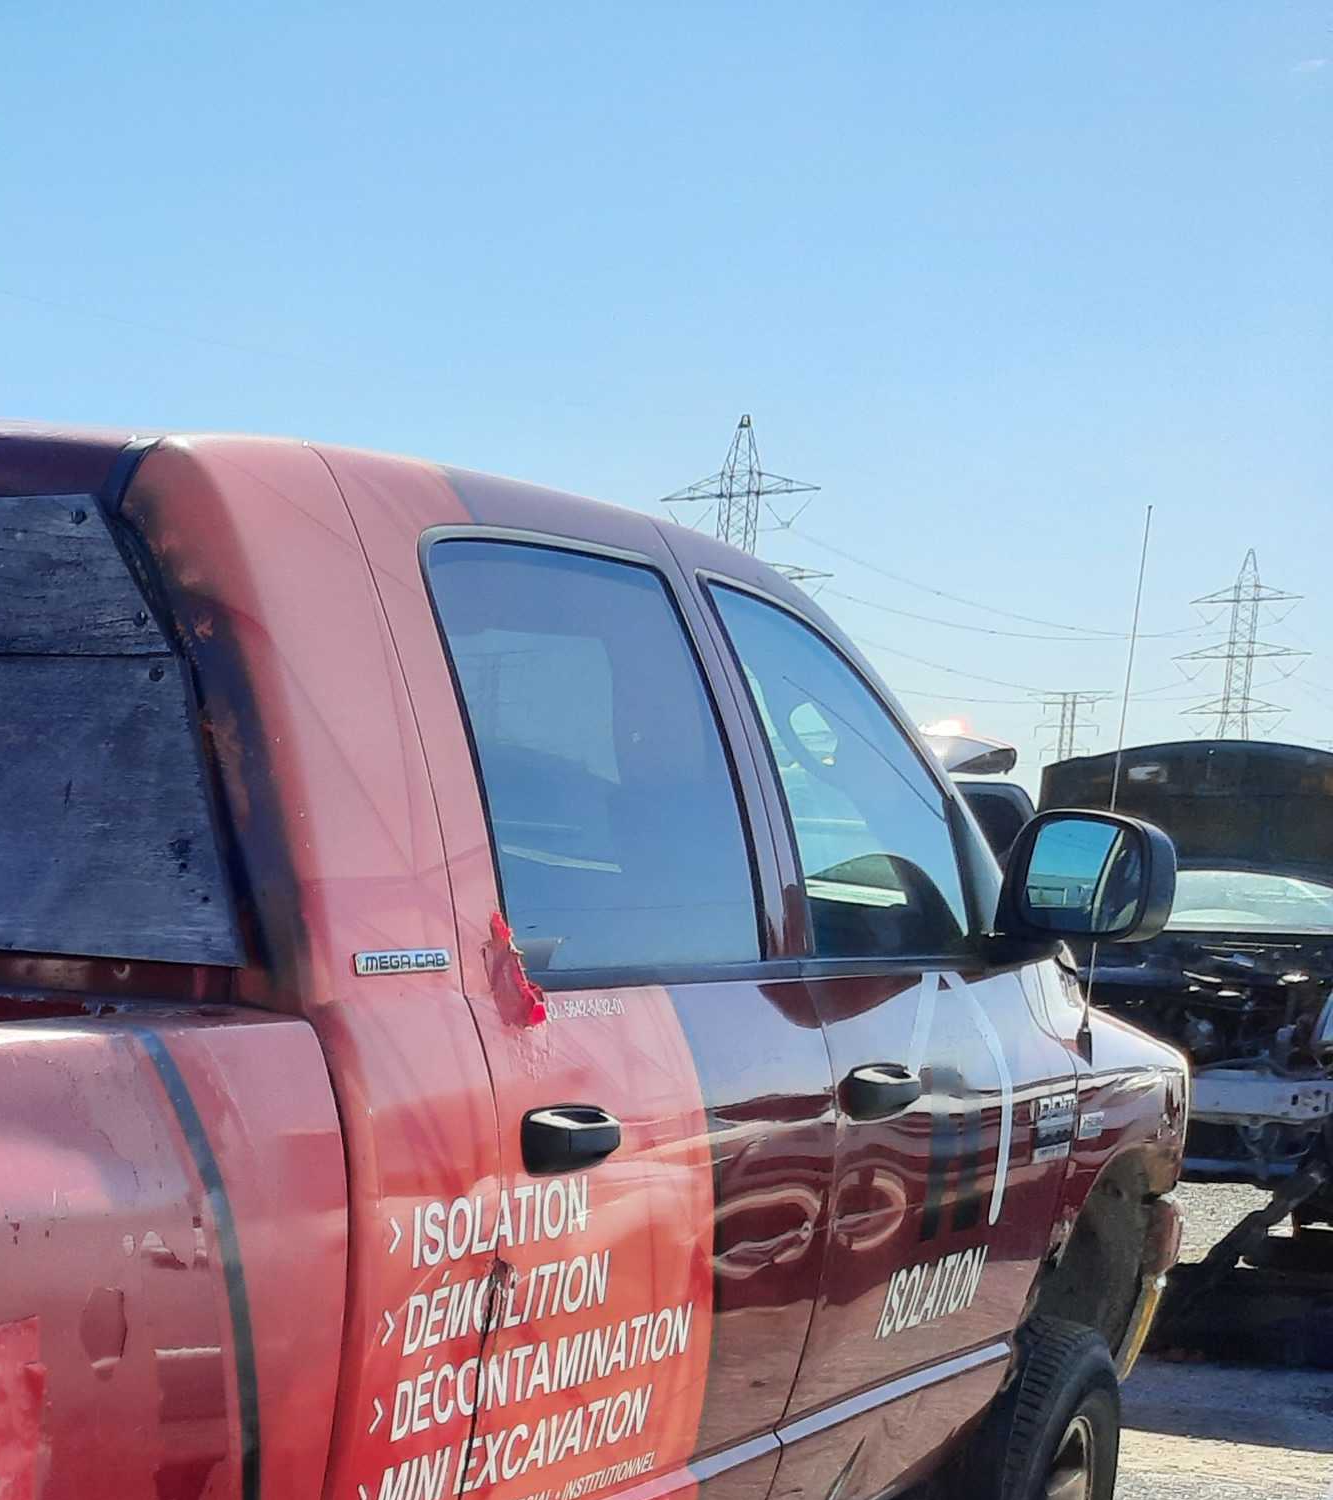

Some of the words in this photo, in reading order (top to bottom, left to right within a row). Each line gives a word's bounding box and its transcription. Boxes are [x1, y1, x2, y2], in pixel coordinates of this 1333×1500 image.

[364, 954, 411, 972] MEGA
[415, 952, 447, 968] CAB
[412, 1175, 589, 1270] ISOLATION
[401, 1250, 610, 1357] DÉMOLITION
[875, 1245, 989, 1340] ISOLATION
[390, 1302, 694, 1442] DÉCONTAMINATION
[453, 1384, 653, 1496] EXCAVATION
